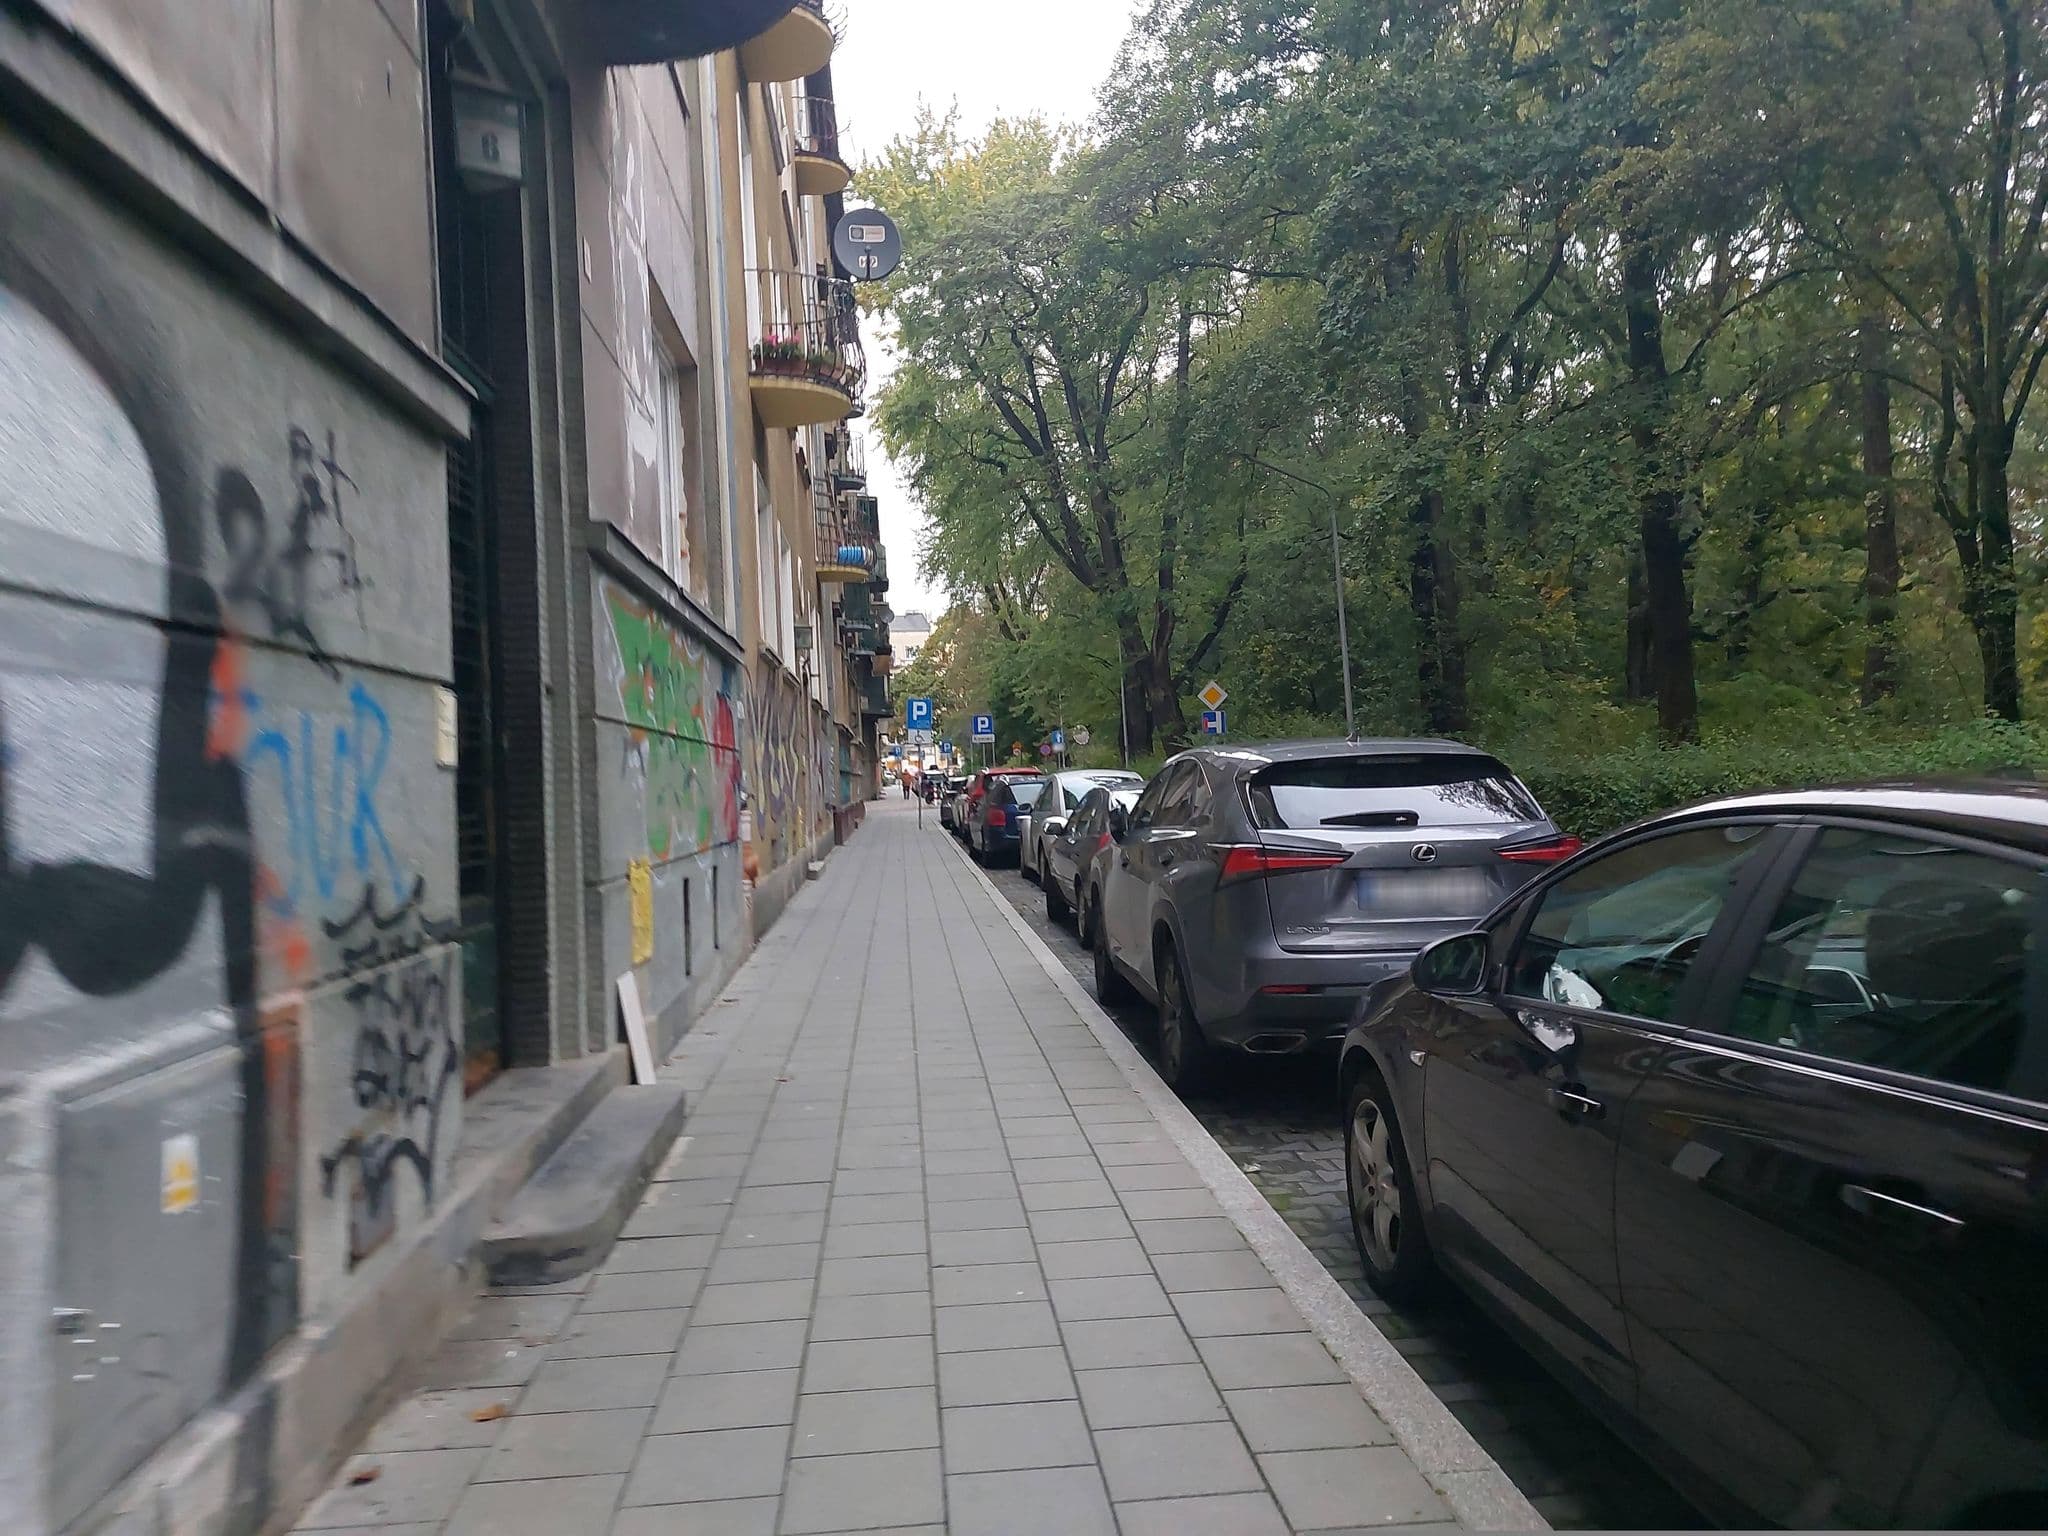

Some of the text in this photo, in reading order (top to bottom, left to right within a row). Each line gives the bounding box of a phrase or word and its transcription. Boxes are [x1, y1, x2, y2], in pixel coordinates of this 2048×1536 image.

[912, 701, 927, 721] P
[977, 716, 989, 733] P
[943, 742, 951, 752] P
[1287, 926, 1330, 934] LEXUS
